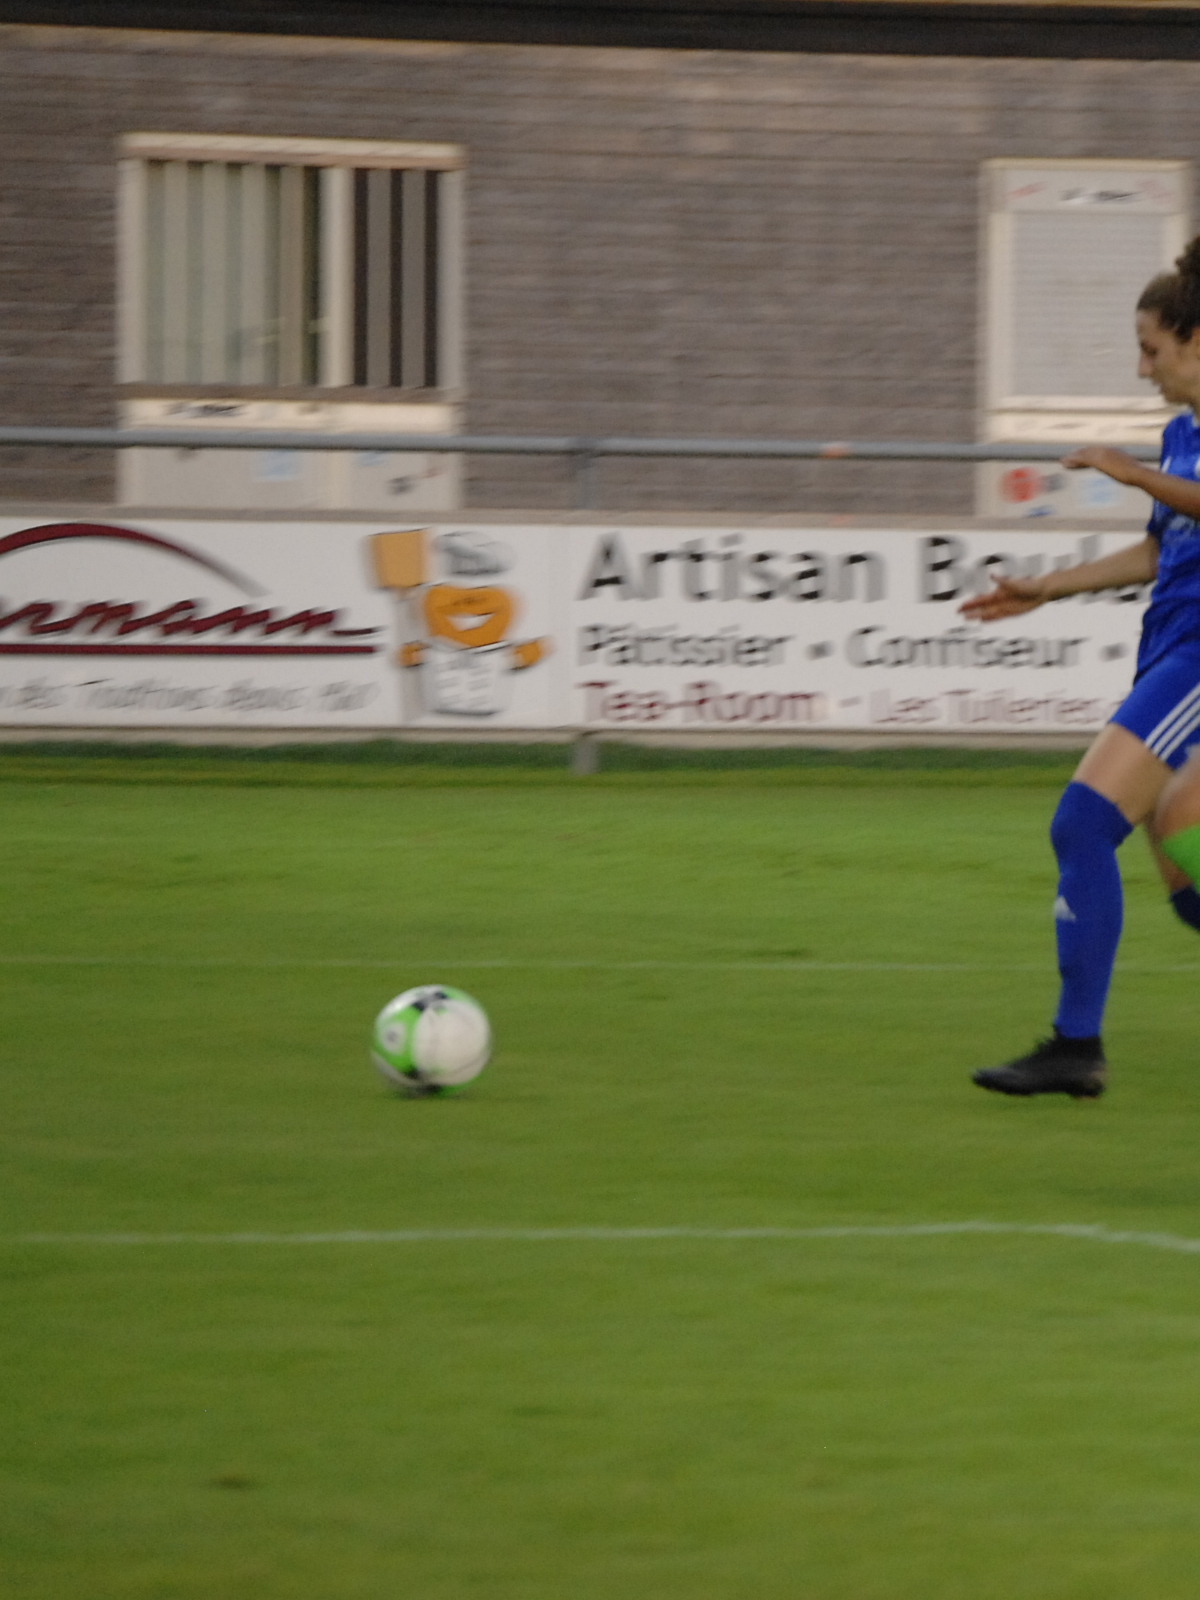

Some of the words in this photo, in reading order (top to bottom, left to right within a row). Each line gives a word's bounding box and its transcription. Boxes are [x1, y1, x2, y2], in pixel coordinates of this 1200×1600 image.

[577, 531, 886, 602] Artisan
[847, 624, 1088, 668] Confiseur
[574, 680, 824, 722] Tea-Room
